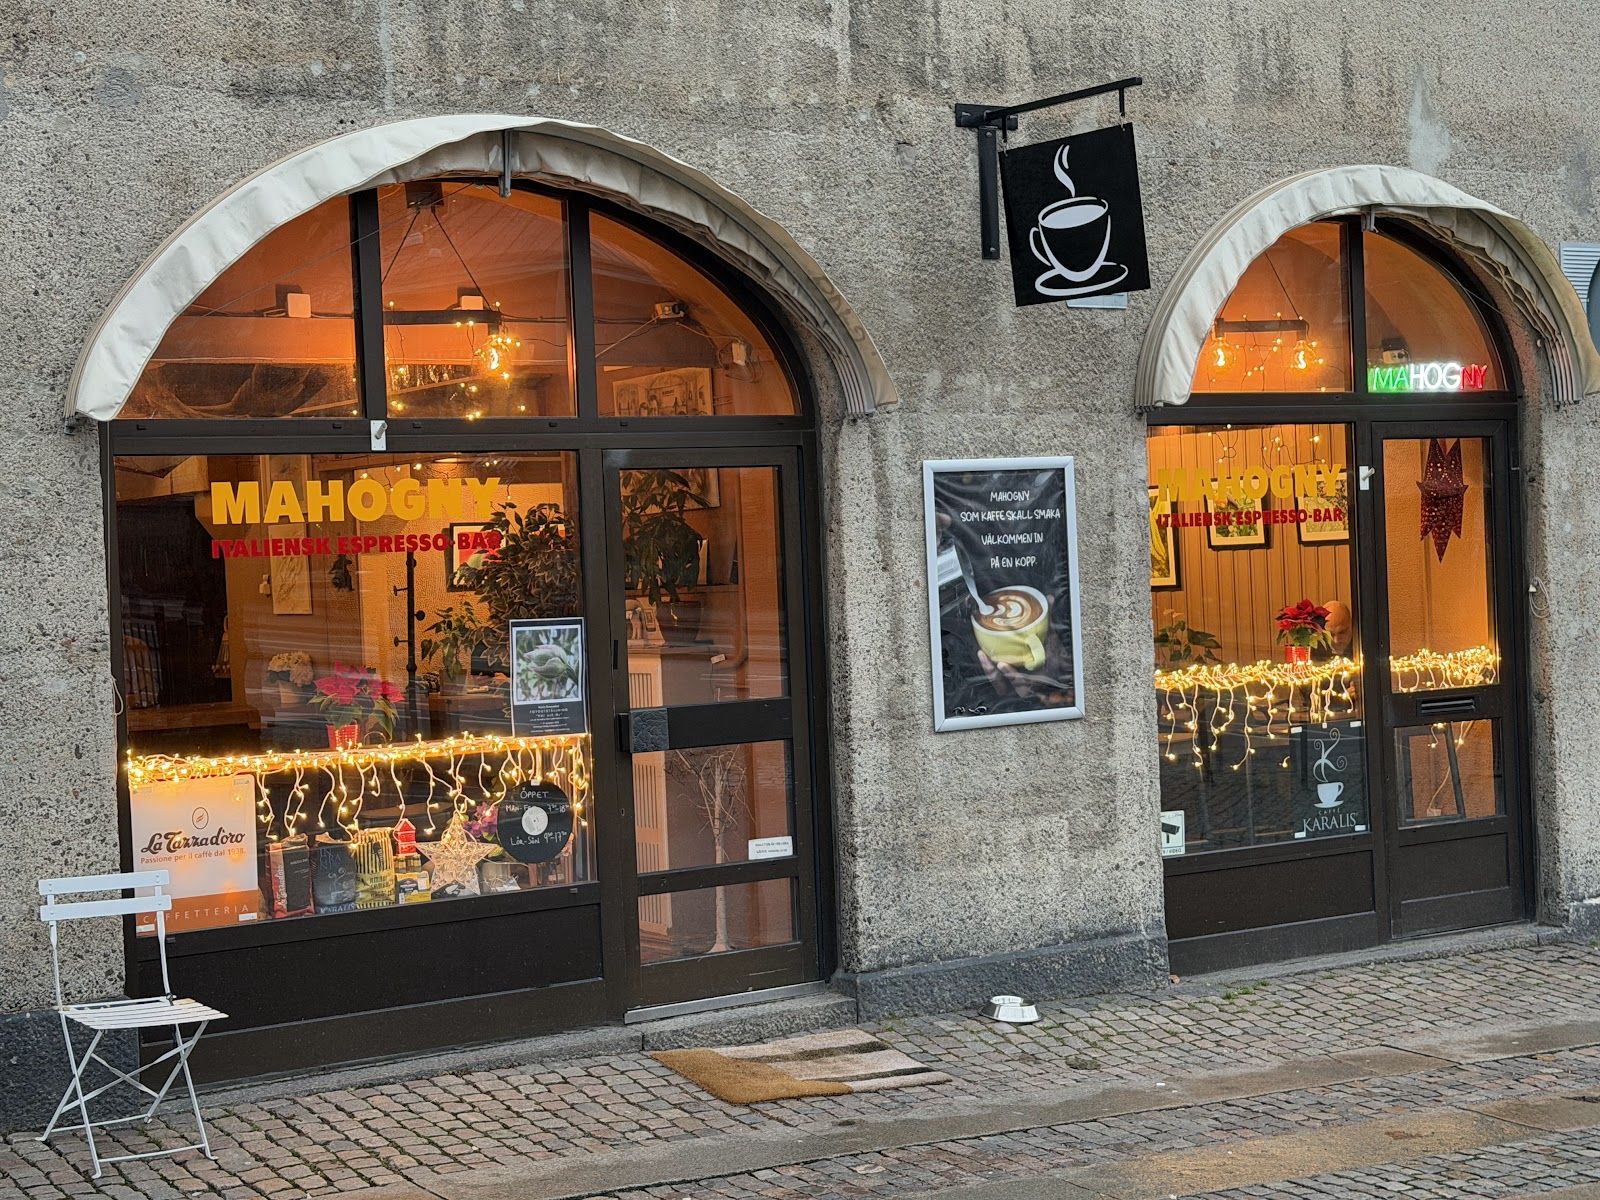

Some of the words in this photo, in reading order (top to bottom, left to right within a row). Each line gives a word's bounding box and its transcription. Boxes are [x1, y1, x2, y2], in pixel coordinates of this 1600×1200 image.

[1373, 362, 1488, 390] MAHOGNY
[1157, 464, 1342, 502] MAHOGNY
[210, 477, 500, 524] MAHOGNY
[990, 490, 1030, 502] MAHOGNY
[960, 511, 980, 522] SOM
[981, 510, 1005, 522] KAFFE
[1005, 509, 1033, 520] SKALL
[1033, 508, 1061, 519] SMAKA
[1156, 512, 1232, 529] ITALIENSK
[1236, 507, 1343, 526] ESPRESSO-BAR
[211, 536, 331, 559] ITALIENSK
[981, 533, 1033, 545] VÄLKOMMEN
[1033, 532, 1043, 543] IN
[990, 556, 1000, 568] PÅ
[1001, 557, 1013, 567] EN
[520, 787, 549, 799] ÖPPET
[1303, 812, 1357, 834] KARALIS
[141, 833, 163, 855] La
[141, 855, 172, 864] Passione
[174, 854, 186, 863] per
[188, 851, 193, 859] il
[194, 850, 213, 859] caffè
[214, 848, 225, 856] dal
